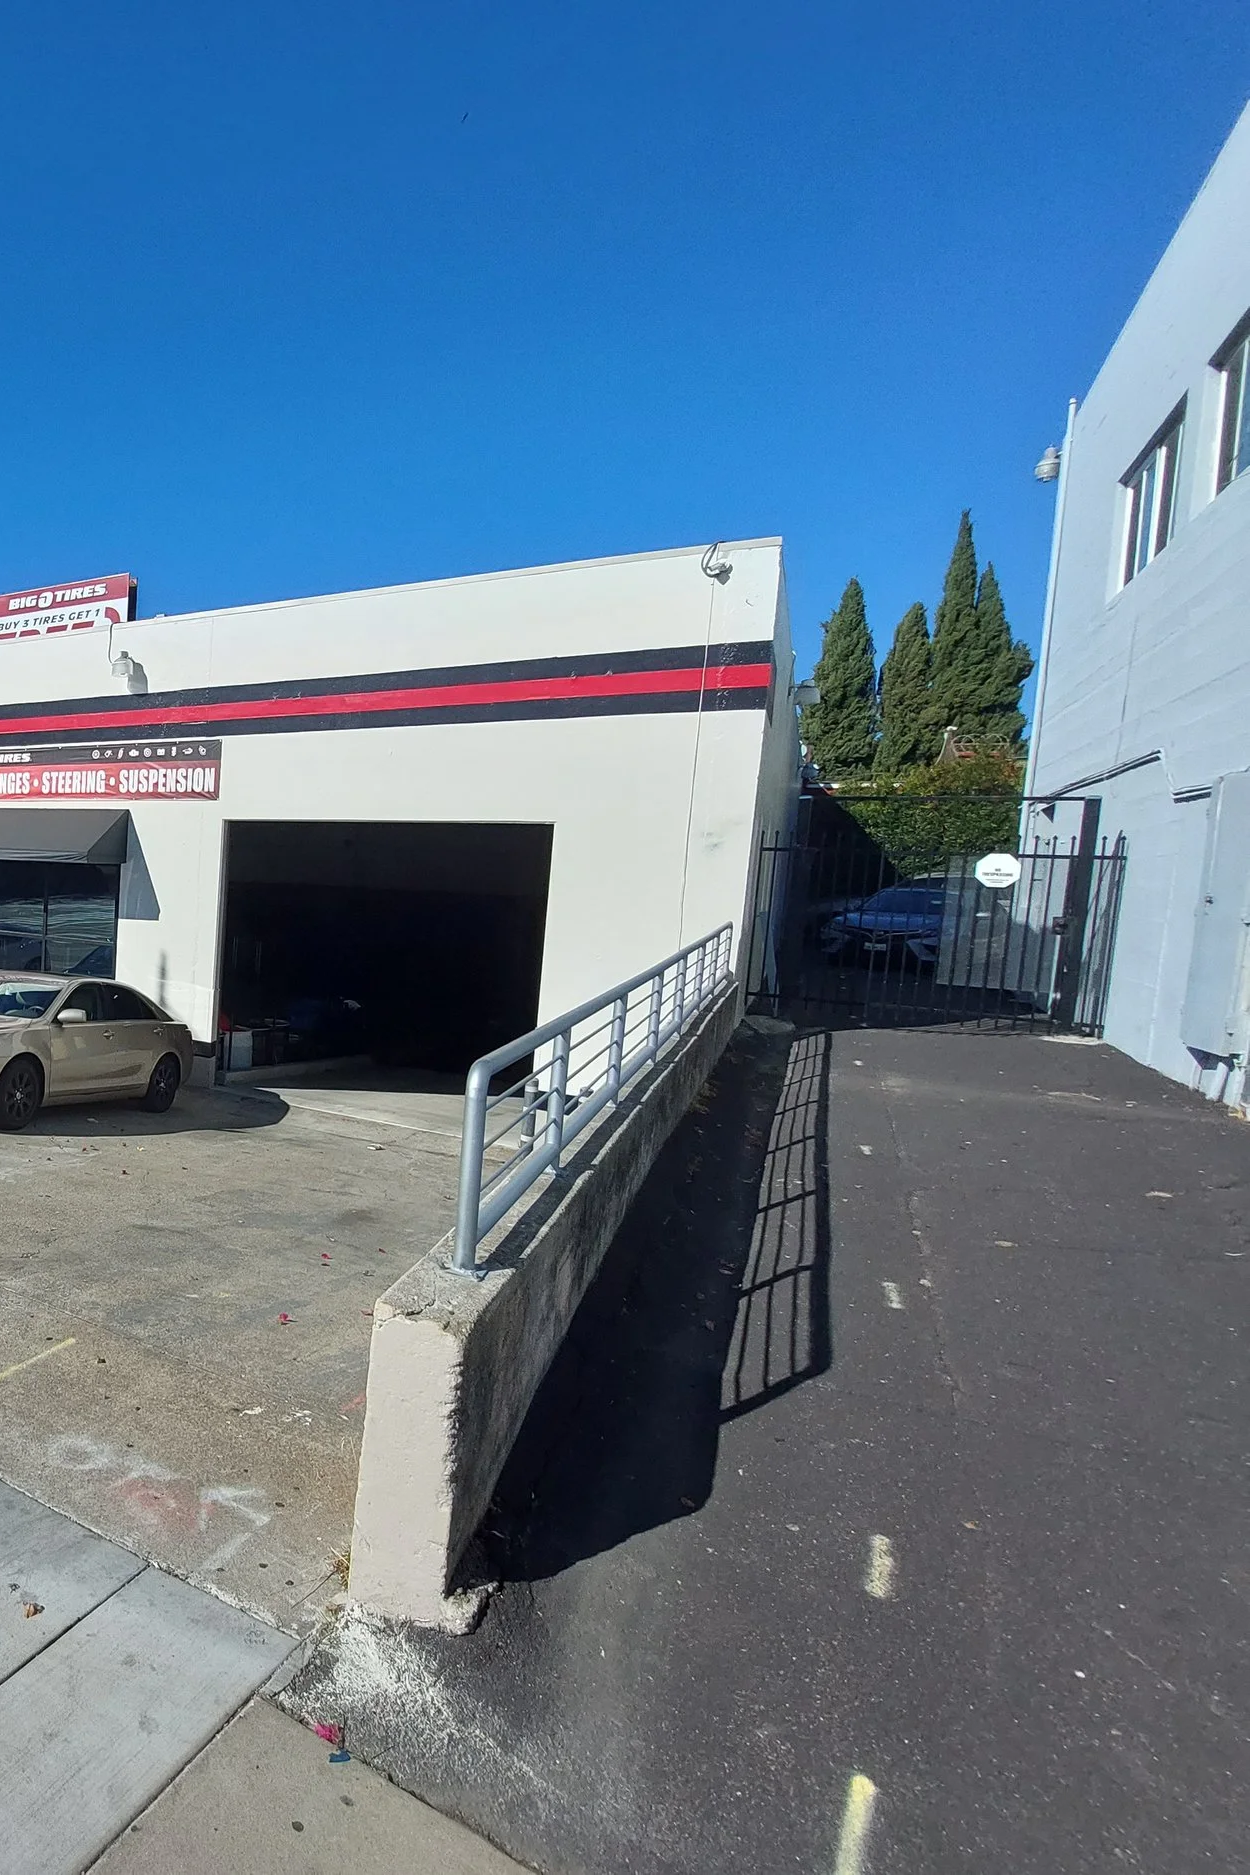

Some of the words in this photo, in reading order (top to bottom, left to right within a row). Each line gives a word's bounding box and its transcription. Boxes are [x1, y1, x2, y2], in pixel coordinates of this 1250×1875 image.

[8, 596, 38, 611] BIG
[37, 591, 54, 609] O
[54, 583, 107, 603] TIRES
[22, 619, 29, 628] 3
[33, 613, 65, 627] TIRES
[68, 609, 92, 621] GET
[94, 608, 101, 617] 1
[41, 769, 106, 794] STEERING
[119, 767, 216, 793] SUSPENSION
